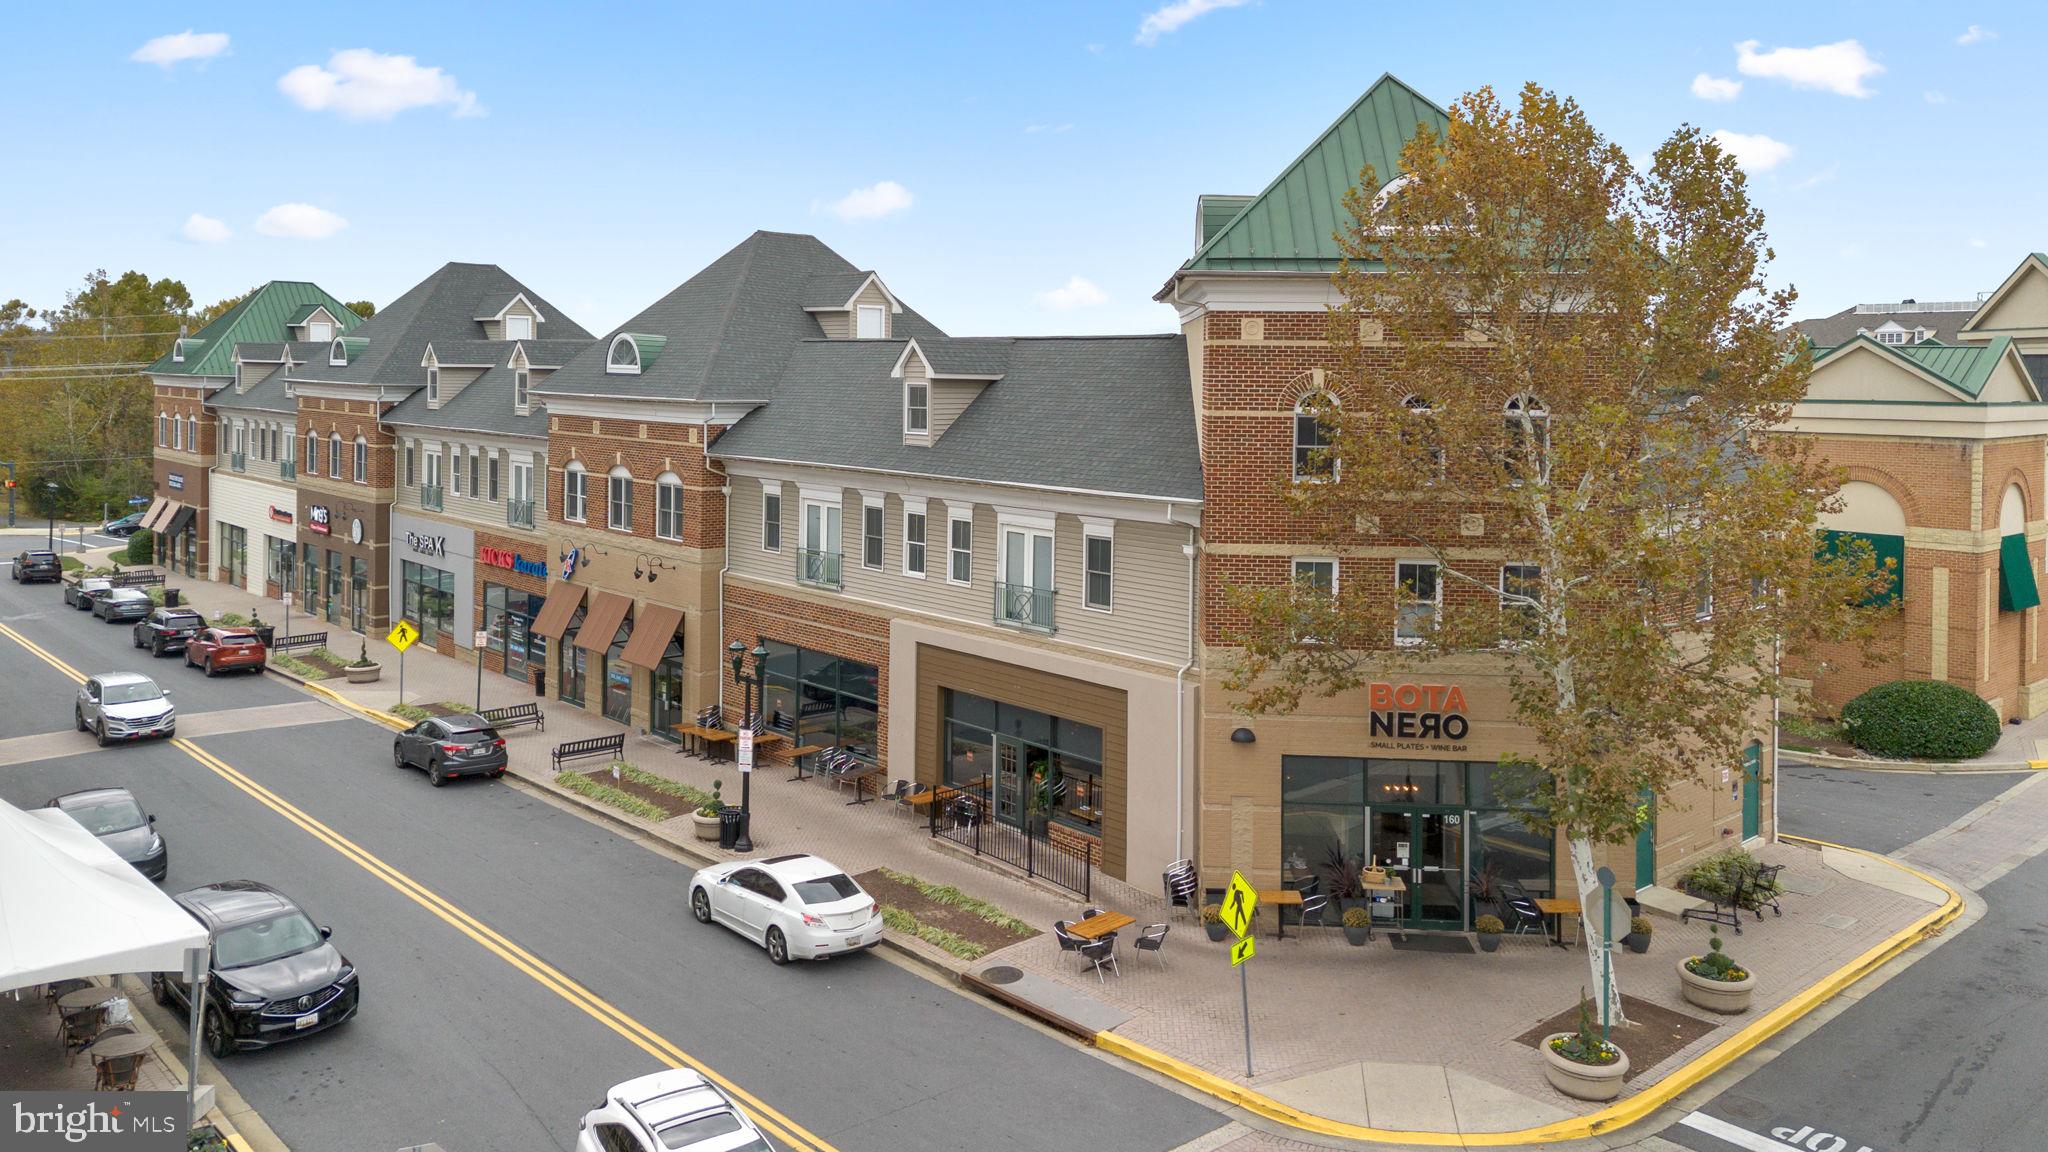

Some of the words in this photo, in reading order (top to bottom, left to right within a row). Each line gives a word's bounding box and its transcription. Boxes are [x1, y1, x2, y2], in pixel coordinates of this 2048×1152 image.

[405, 531, 418, 546] The
[419, 535, 434, 551] SPA
[480, 546, 513, 569] KICKS
[1369, 682, 1470, 712] BOTA
[1396, 742, 1425, 751] PLATES
[1430, 744, 1451, 752] WINE
[1443, 814, 1461, 825] 160
